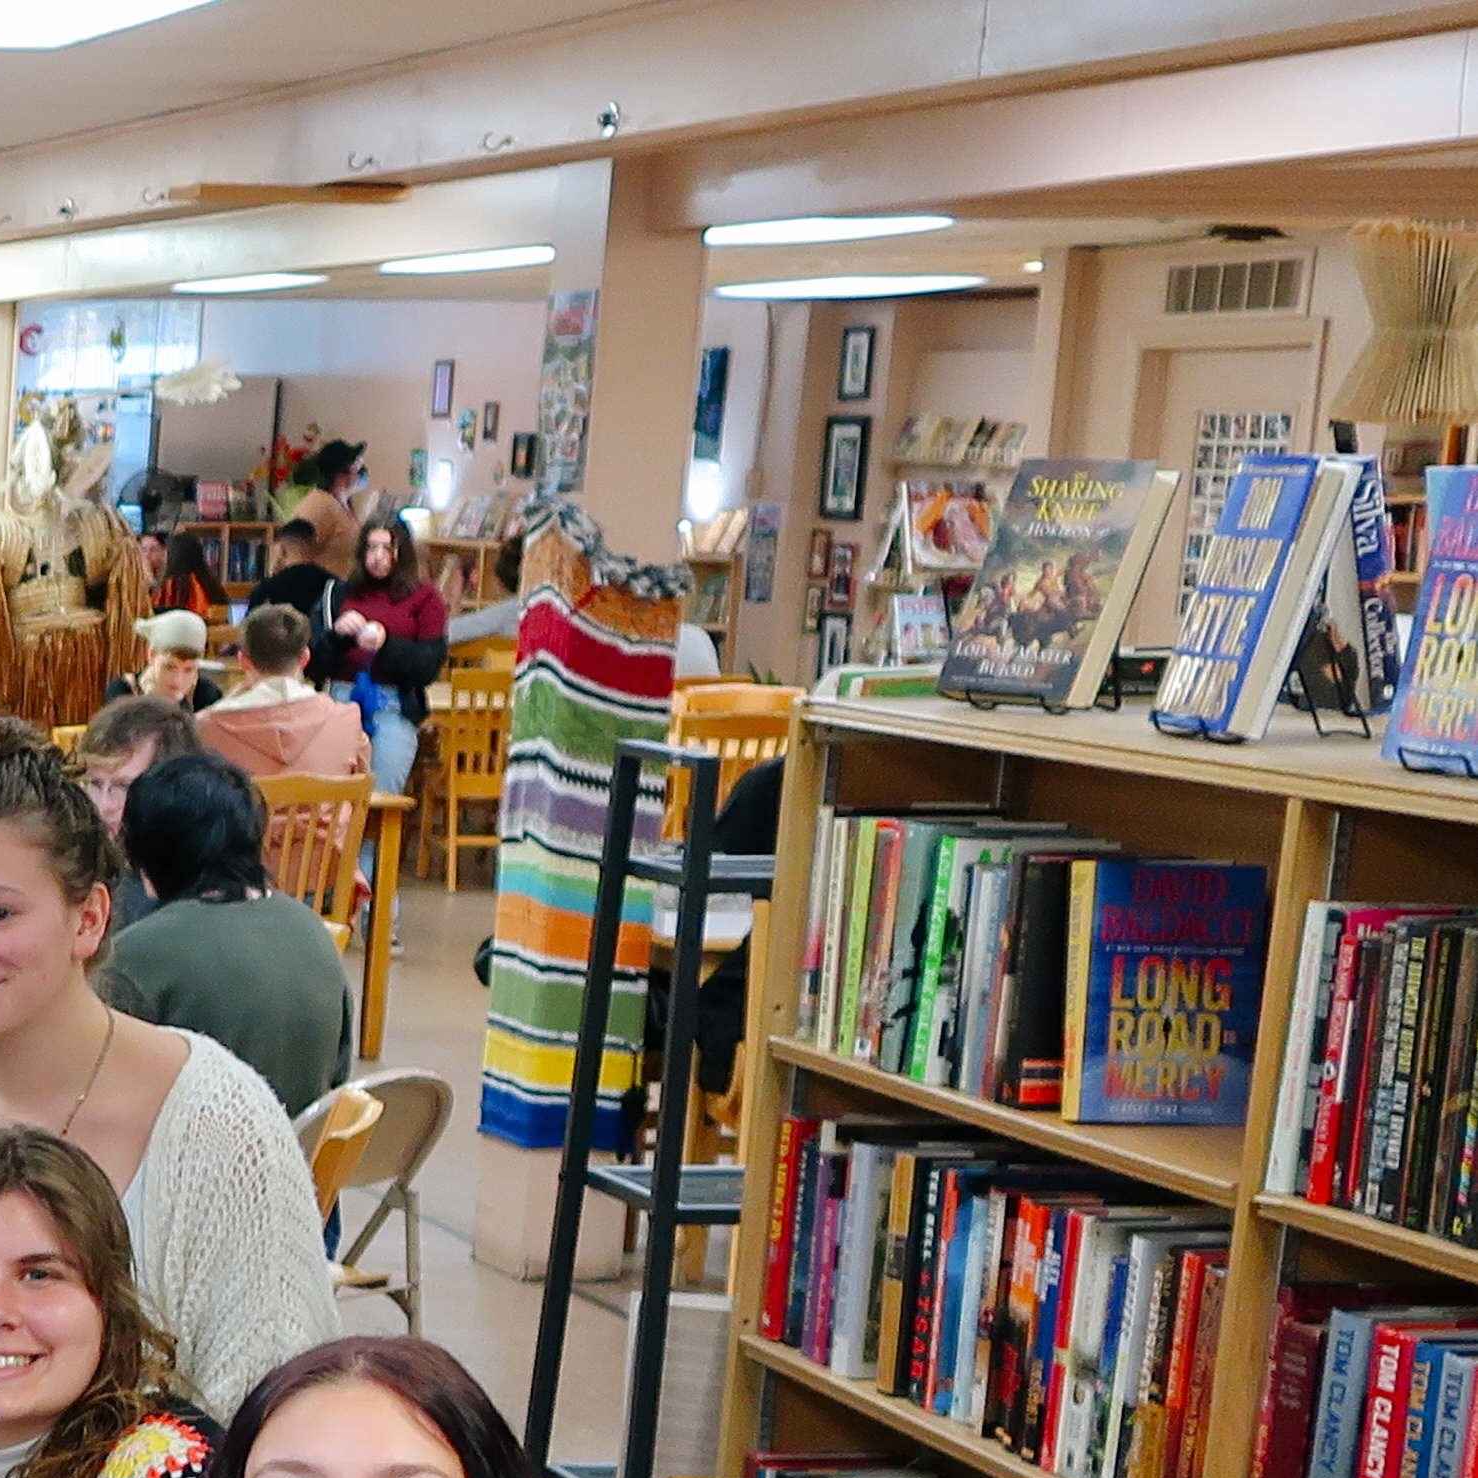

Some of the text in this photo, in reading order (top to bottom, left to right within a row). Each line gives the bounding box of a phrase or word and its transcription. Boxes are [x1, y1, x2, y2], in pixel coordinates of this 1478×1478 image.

[1027, 473, 1128, 500] SHARING
[1035, 500, 1101, 522] KNIFE
[1024, 521, 1093, 539] HORIZON
[1350, 479, 1384, 558] Silva
[1424, 572, 1478, 635] LO
[1363, 596, 1385, 679] Collector
[1412, 634, 1478, 690] ROA
[978, 657, 1035, 677] BUJOLD
[1399, 688, 1478, 742] MERC
[1134, 868, 1229, 904] DAVID
[1101, 904, 1252, 945] BALDACCI
[1109, 954, 1233, 1011] LONG
[1107, 1011, 1223, 1060] ROAD
[1103, 1058, 1225, 1101] MERCY
[1376, 1343, 1401, 1393] TOM
[1408, 1360, 1432, 1411] TOM
[1318, 1328, 1356, 1474] TOM CLANCY
[1440, 1369, 1465, 1420] TOM
